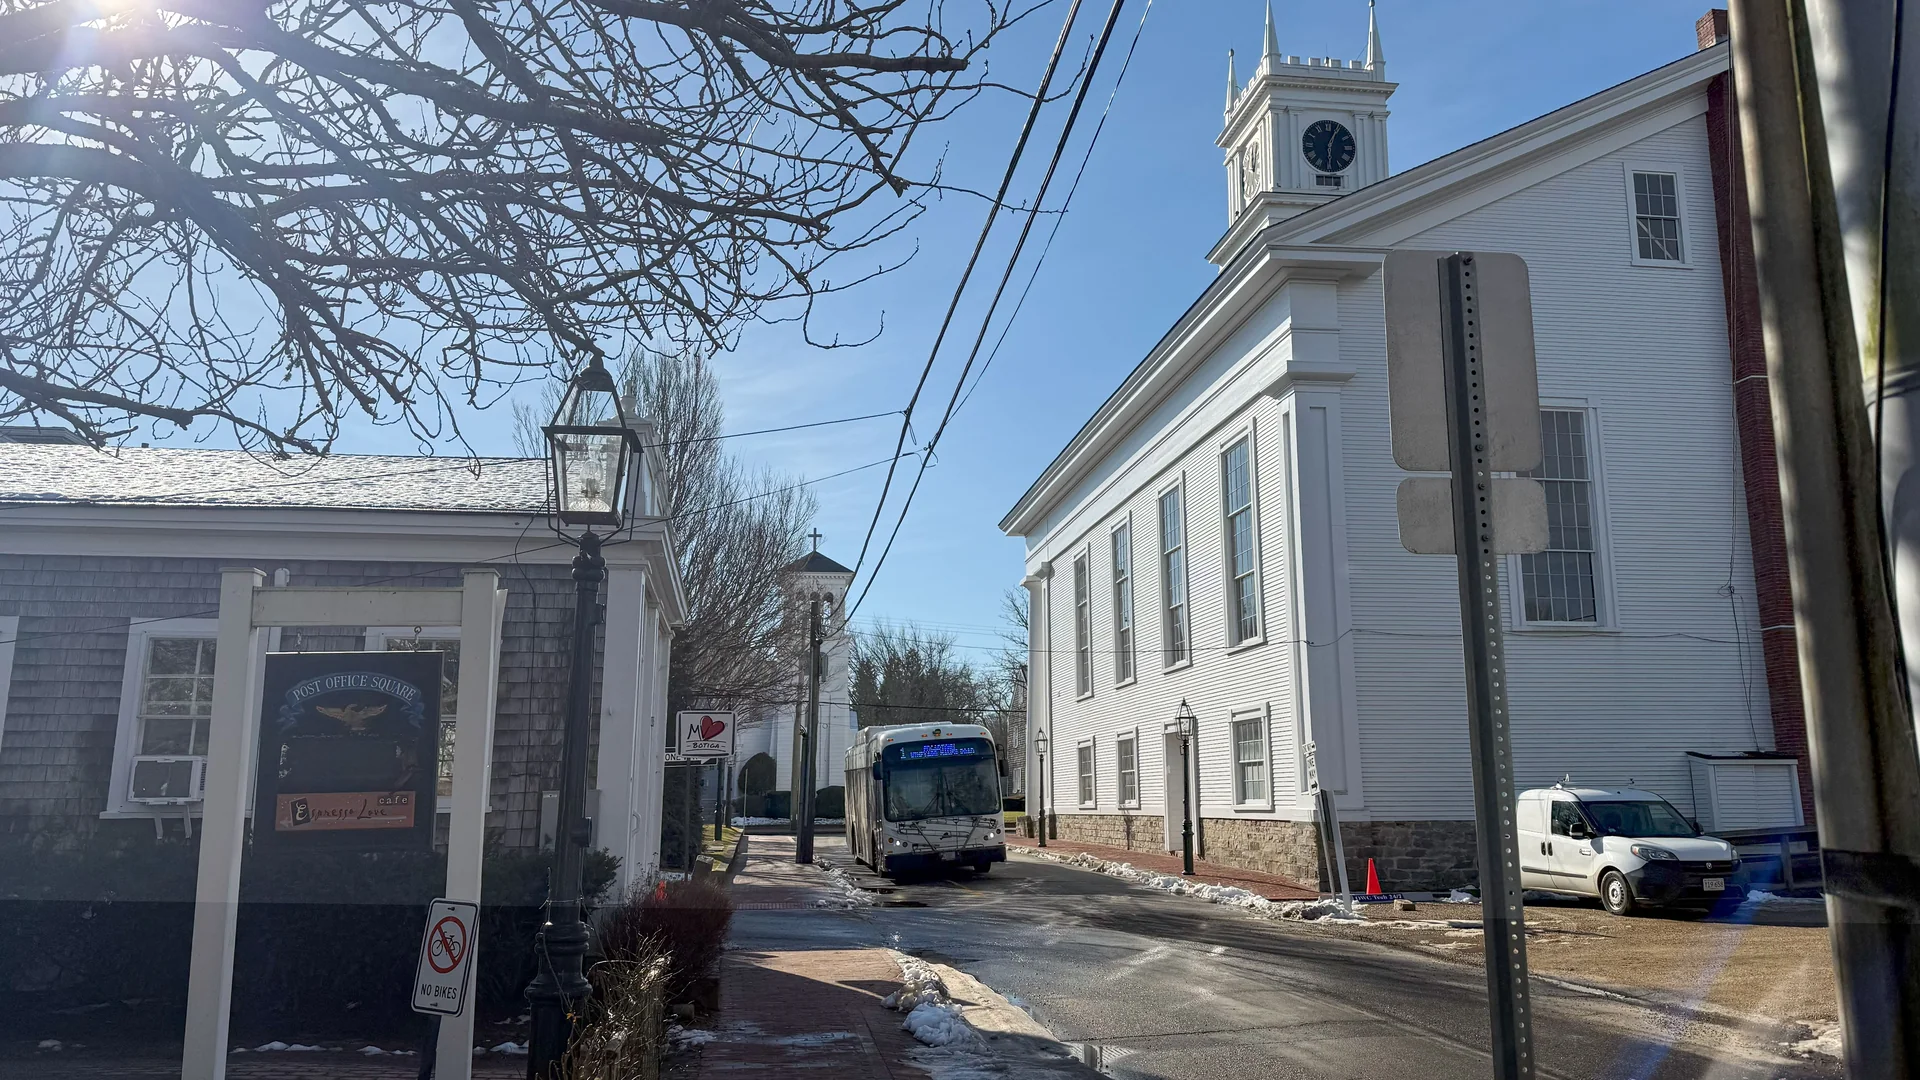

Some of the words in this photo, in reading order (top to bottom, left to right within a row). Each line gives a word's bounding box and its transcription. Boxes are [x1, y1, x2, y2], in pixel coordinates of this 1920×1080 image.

[292, 680, 321, 701] POST
[325, 674, 368, 689] OFFICE
[370, 676, 417, 701] SQUARE
[379, 796, 408, 804] cafe
[295, 800, 354, 821] Espresso
[356, 799, 387, 820] Love
[420, 983, 432, 996] NO
[434, 985, 458, 1000] BIKES
